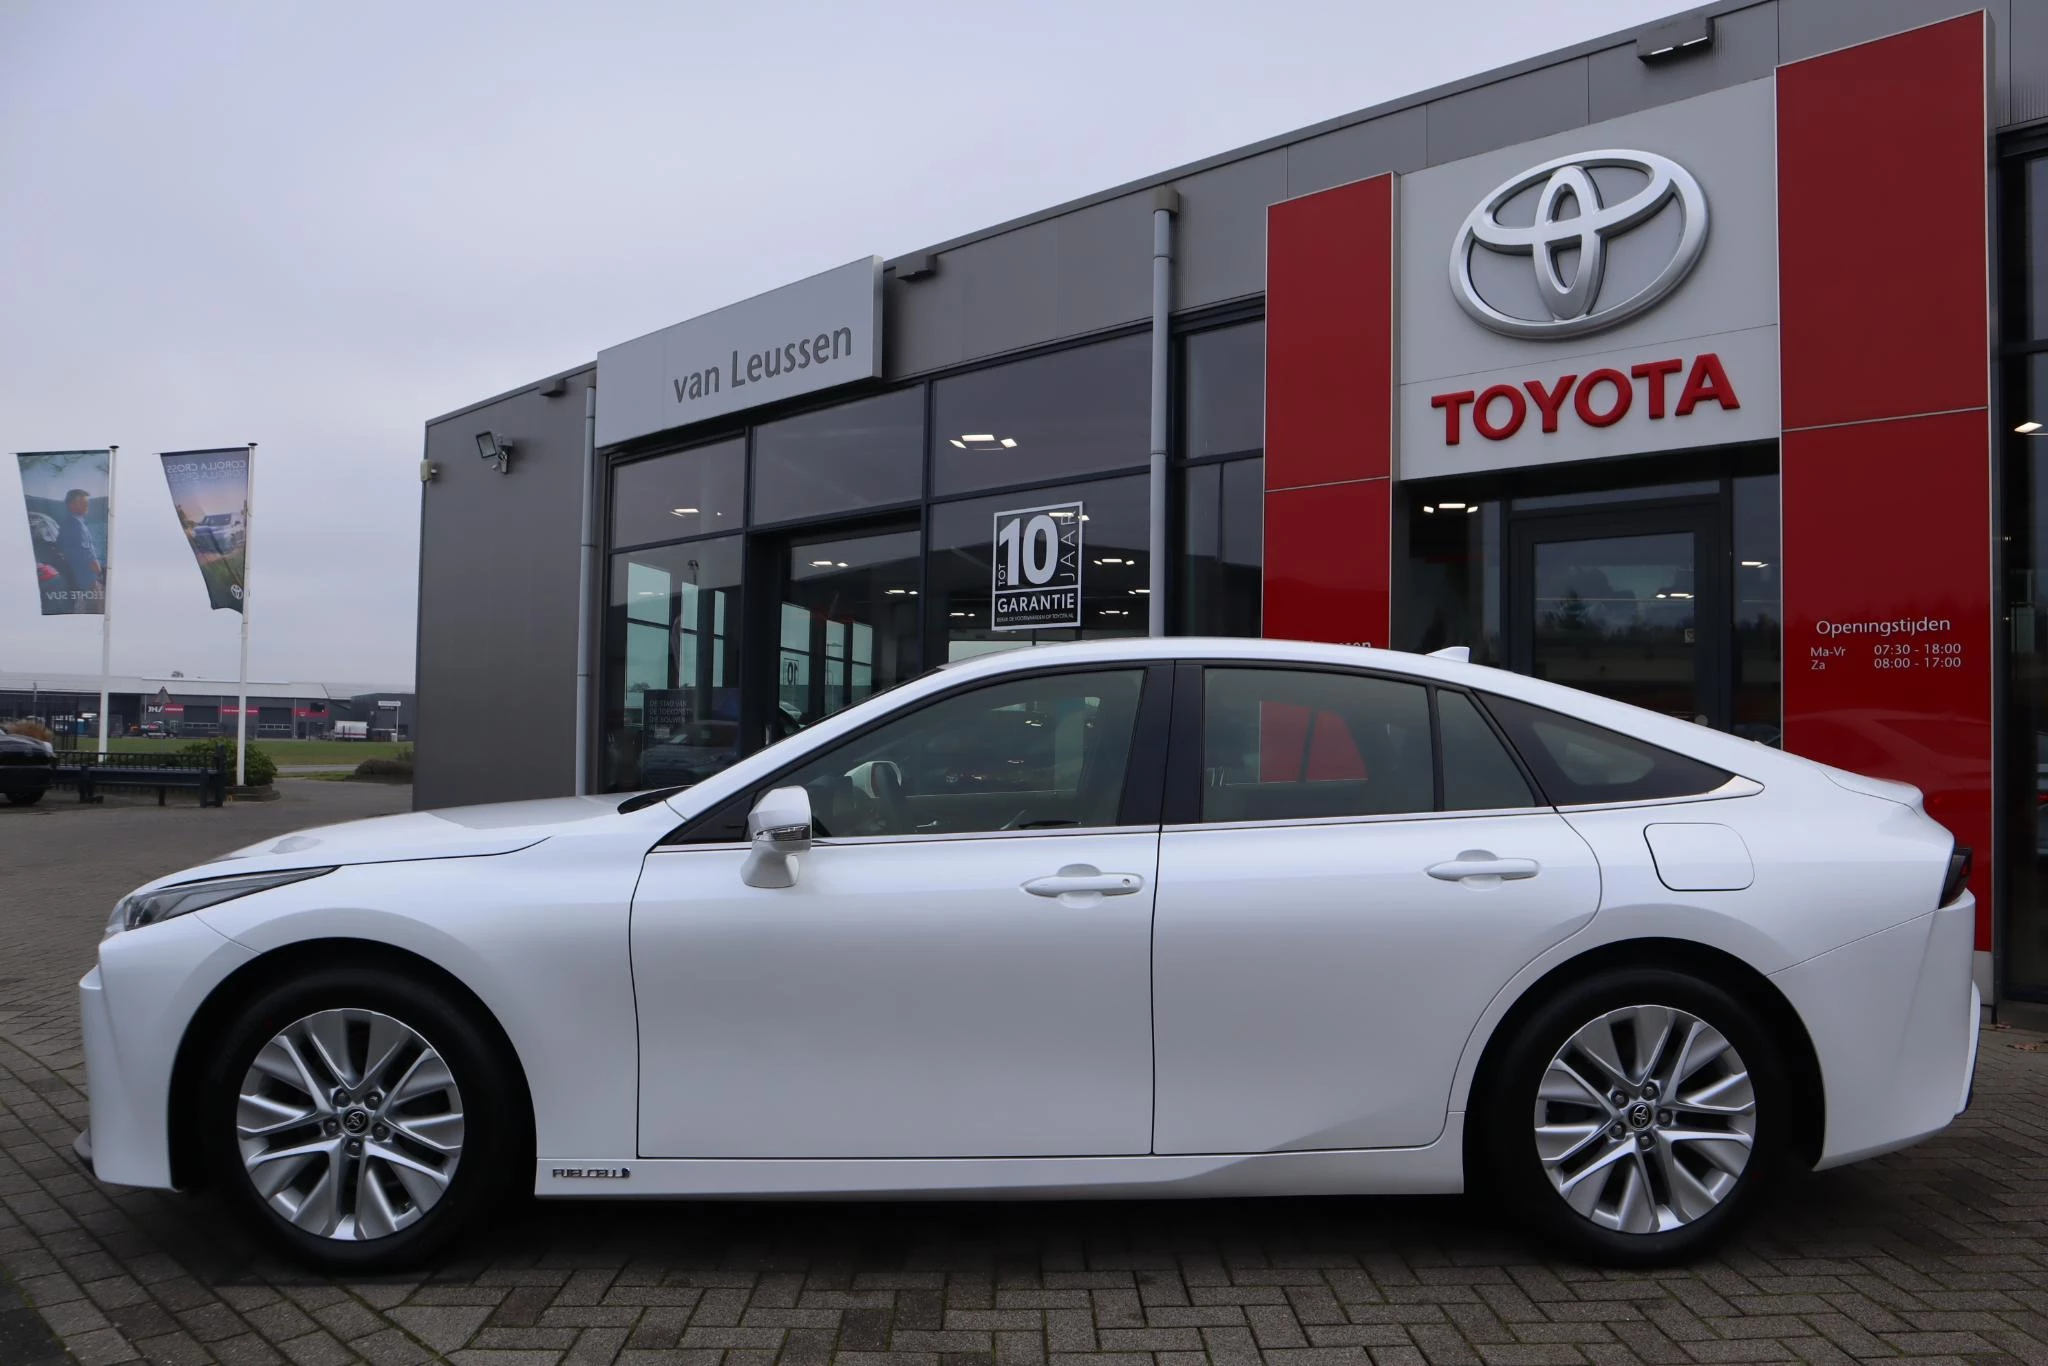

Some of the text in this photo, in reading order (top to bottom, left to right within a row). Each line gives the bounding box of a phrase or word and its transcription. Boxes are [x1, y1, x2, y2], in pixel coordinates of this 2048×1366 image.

[673, 326, 852, 403] van Leussen
[1431, 353, 1740, 445] TOYOTA
[999, 514, 1059, 586] 10
[1060, 511, 1076, 581] JAAR
[998, 564, 1006, 587] TOT
[997, 593, 1075, 613] GARANTIE
[1816, 616, 1951, 638] Openingstijden
[1810, 646, 1846, 657] Ma-Vr
[1874, 644, 1911, 655] 07:30
[1924, 643, 1962, 655] 18:00
[1811, 659, 1826, 670] Za
[1874, 658, 1911, 669] 08:00
[1924, 657, 1962, 669] 17:00
